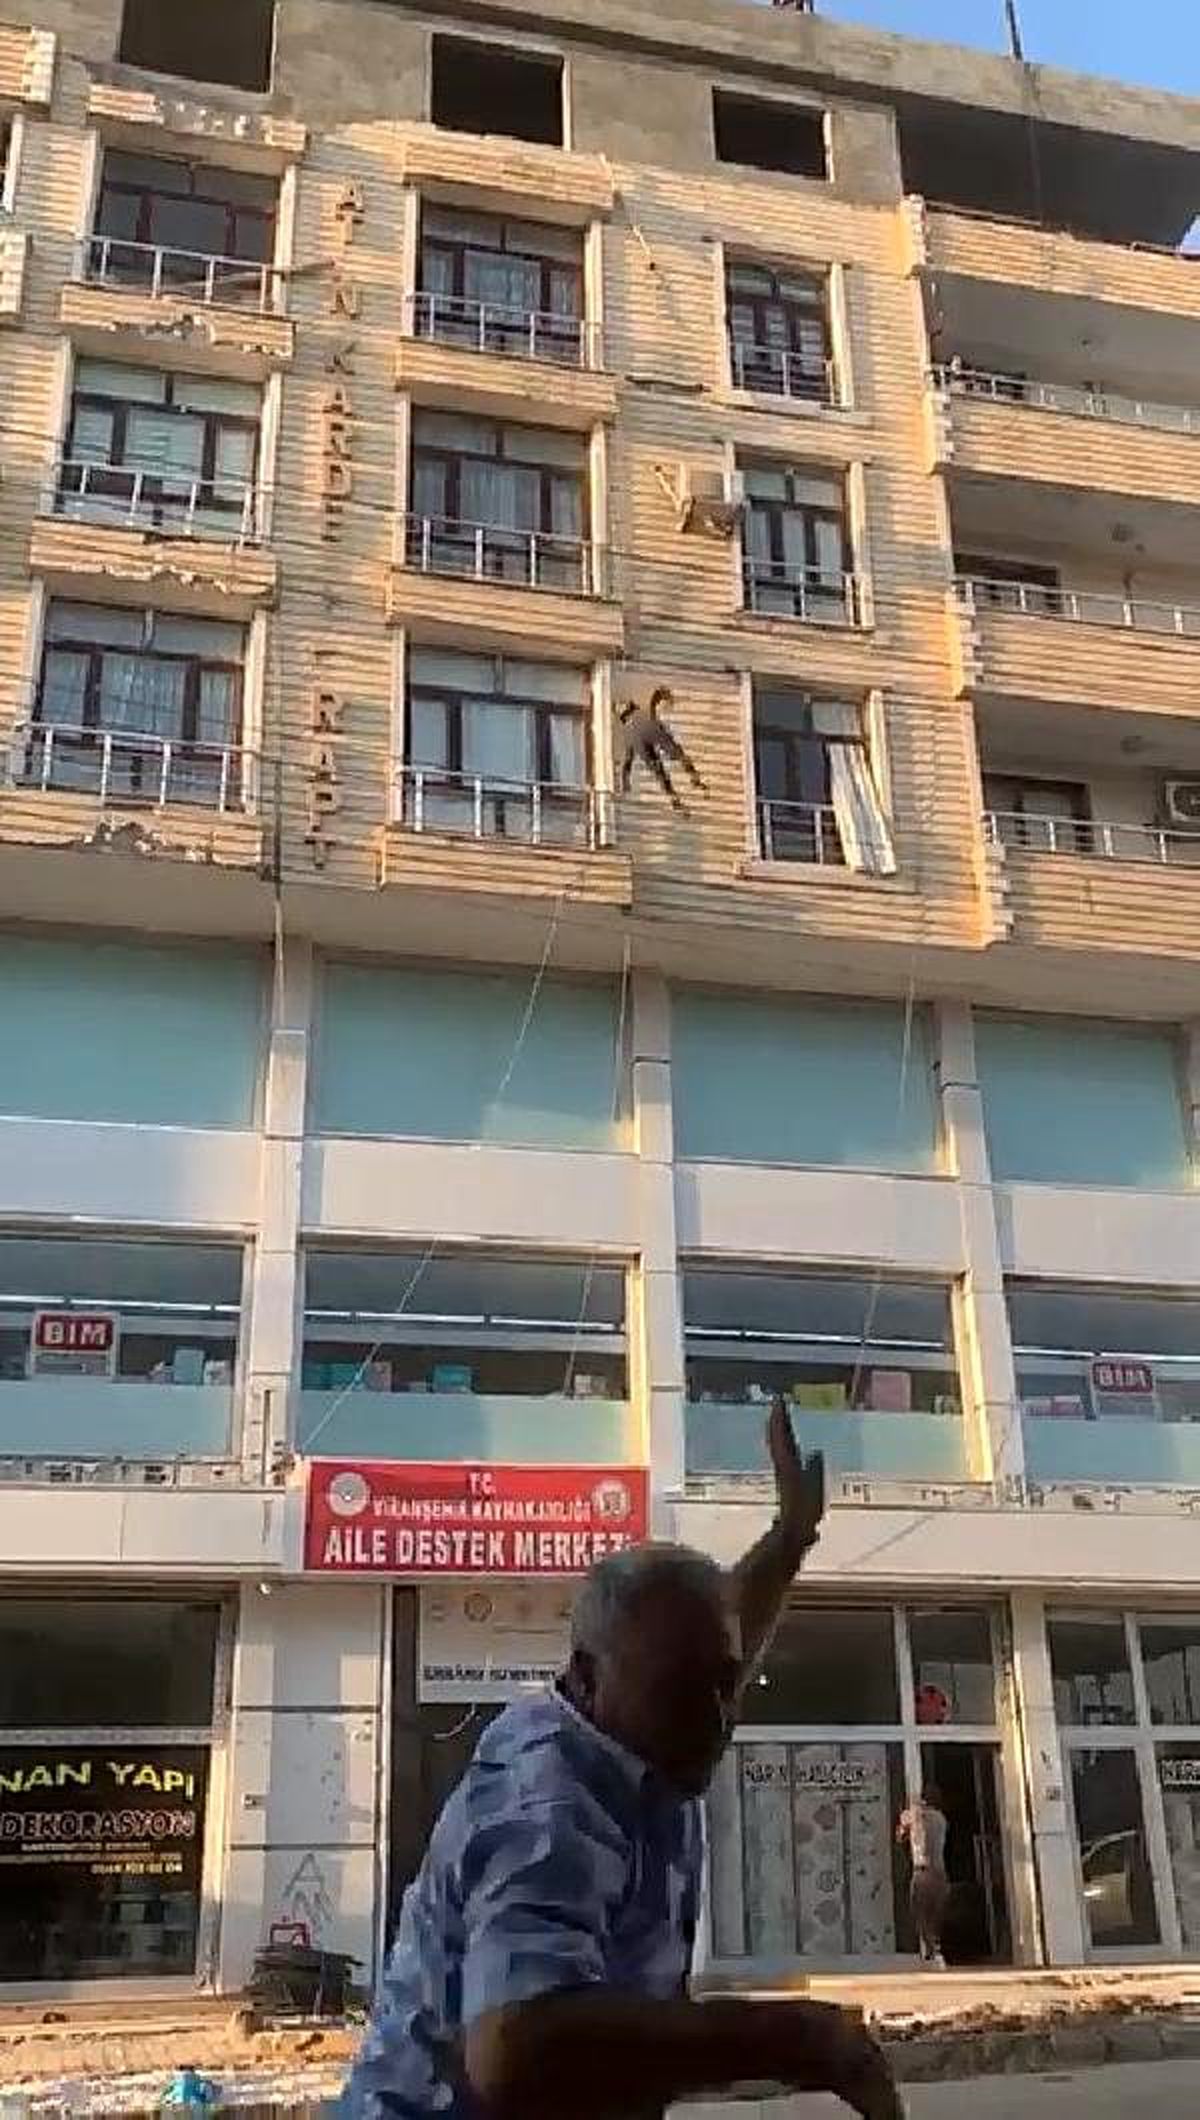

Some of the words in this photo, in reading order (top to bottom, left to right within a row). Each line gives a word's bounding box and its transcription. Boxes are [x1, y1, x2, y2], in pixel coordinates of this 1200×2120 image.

[397, 1529, 505, 1567] DESTEK
[107, 1762, 195, 1800] YAPI
[0, 1810, 196, 1839] DEKORASYON
